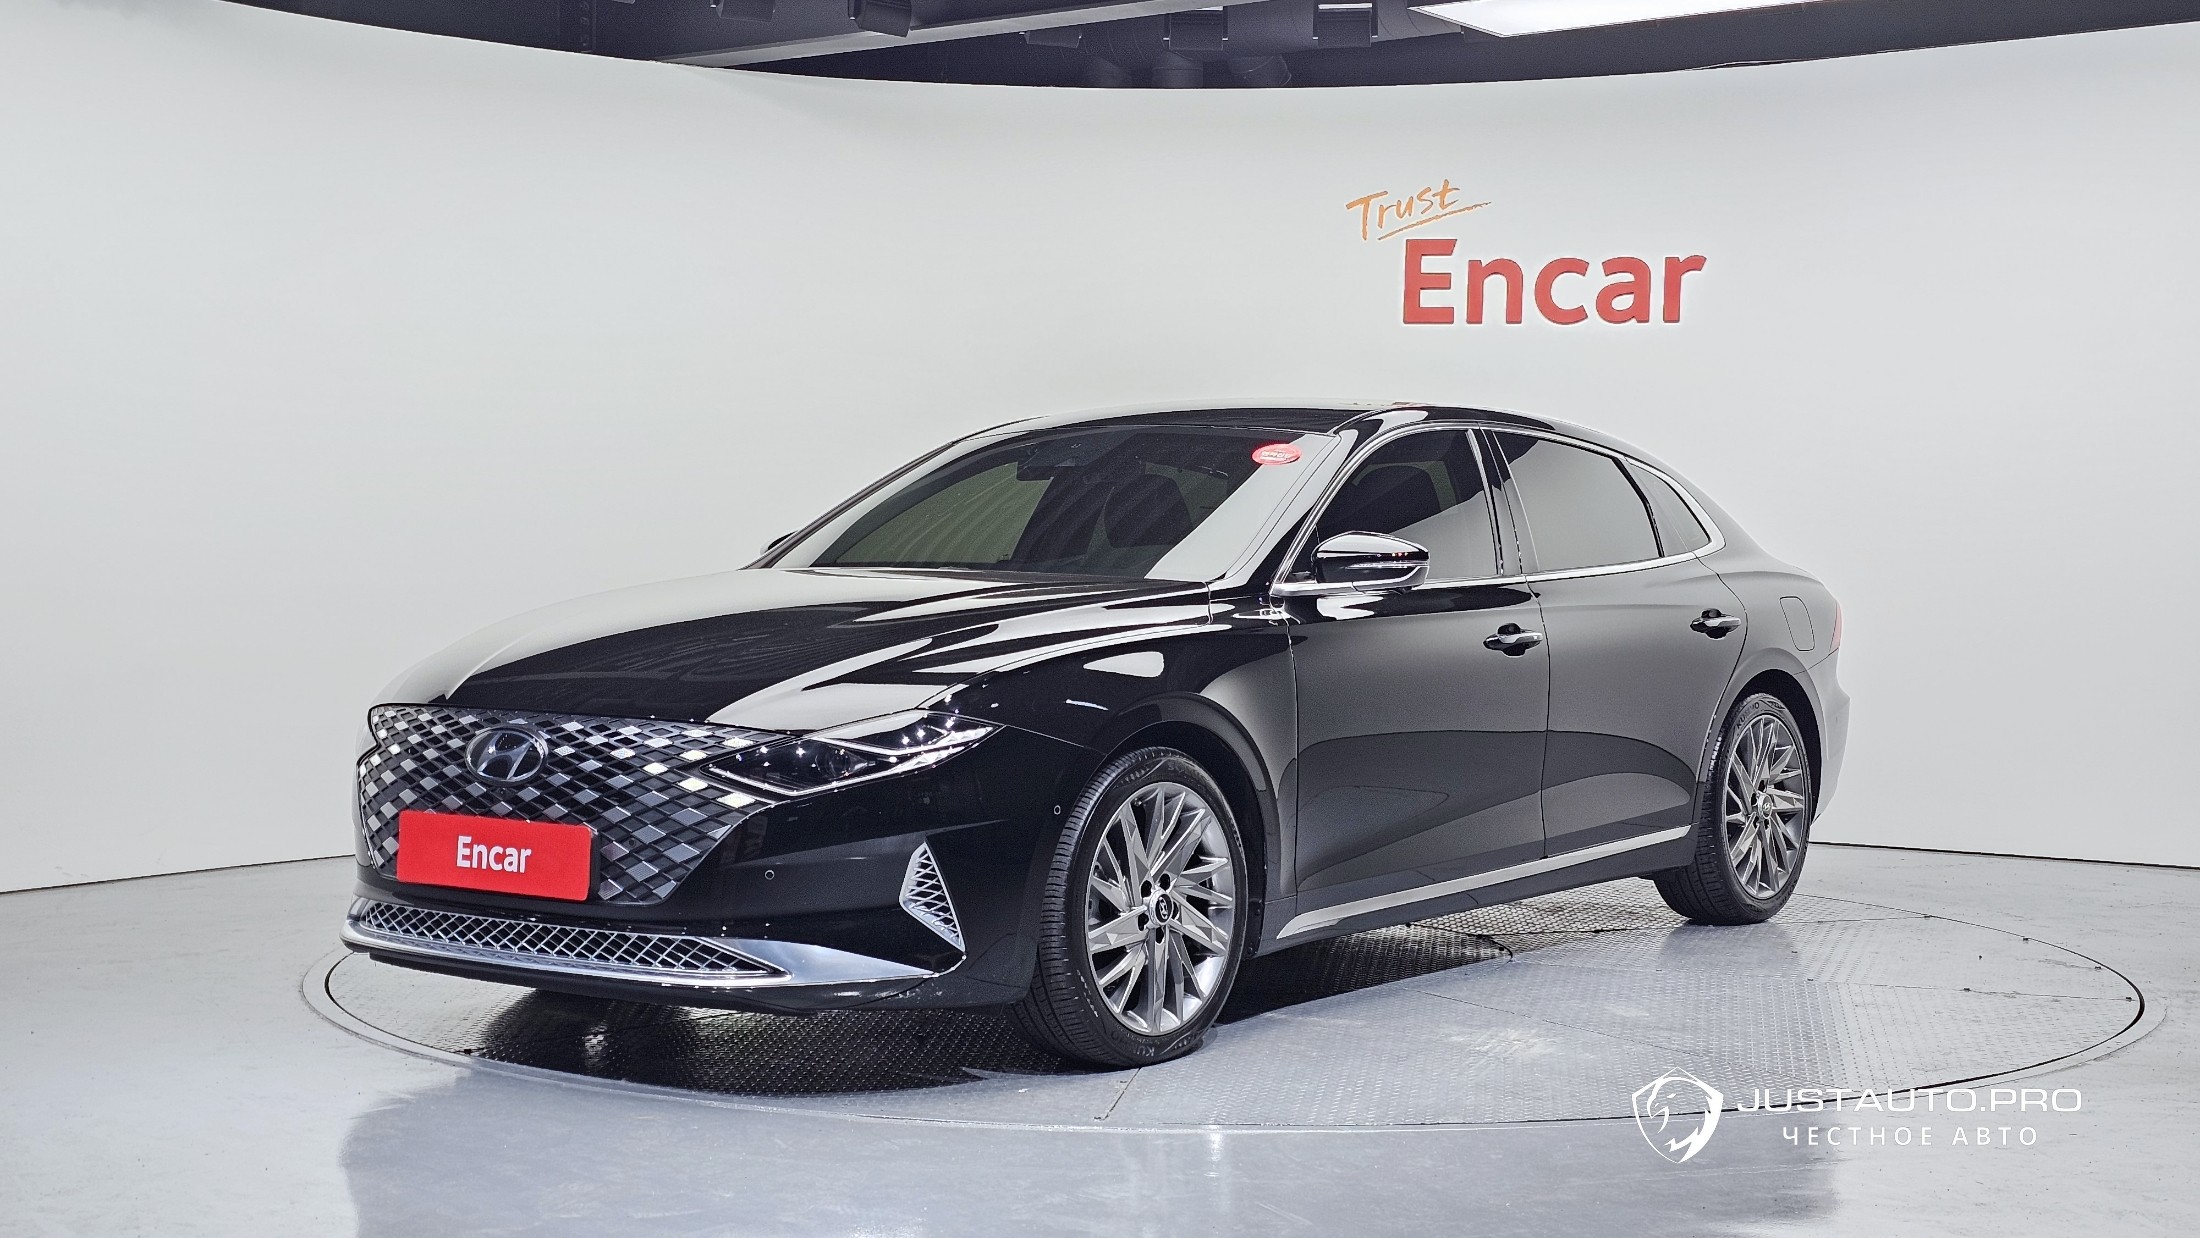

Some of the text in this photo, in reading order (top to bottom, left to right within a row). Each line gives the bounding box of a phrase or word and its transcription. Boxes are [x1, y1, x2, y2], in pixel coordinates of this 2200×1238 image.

[1345, 179, 1461, 241] Trust
[1403, 238, 1707, 325] Encar
[1737, 701, 1760, 729] KUO
[456, 835, 532, 873] Encar
